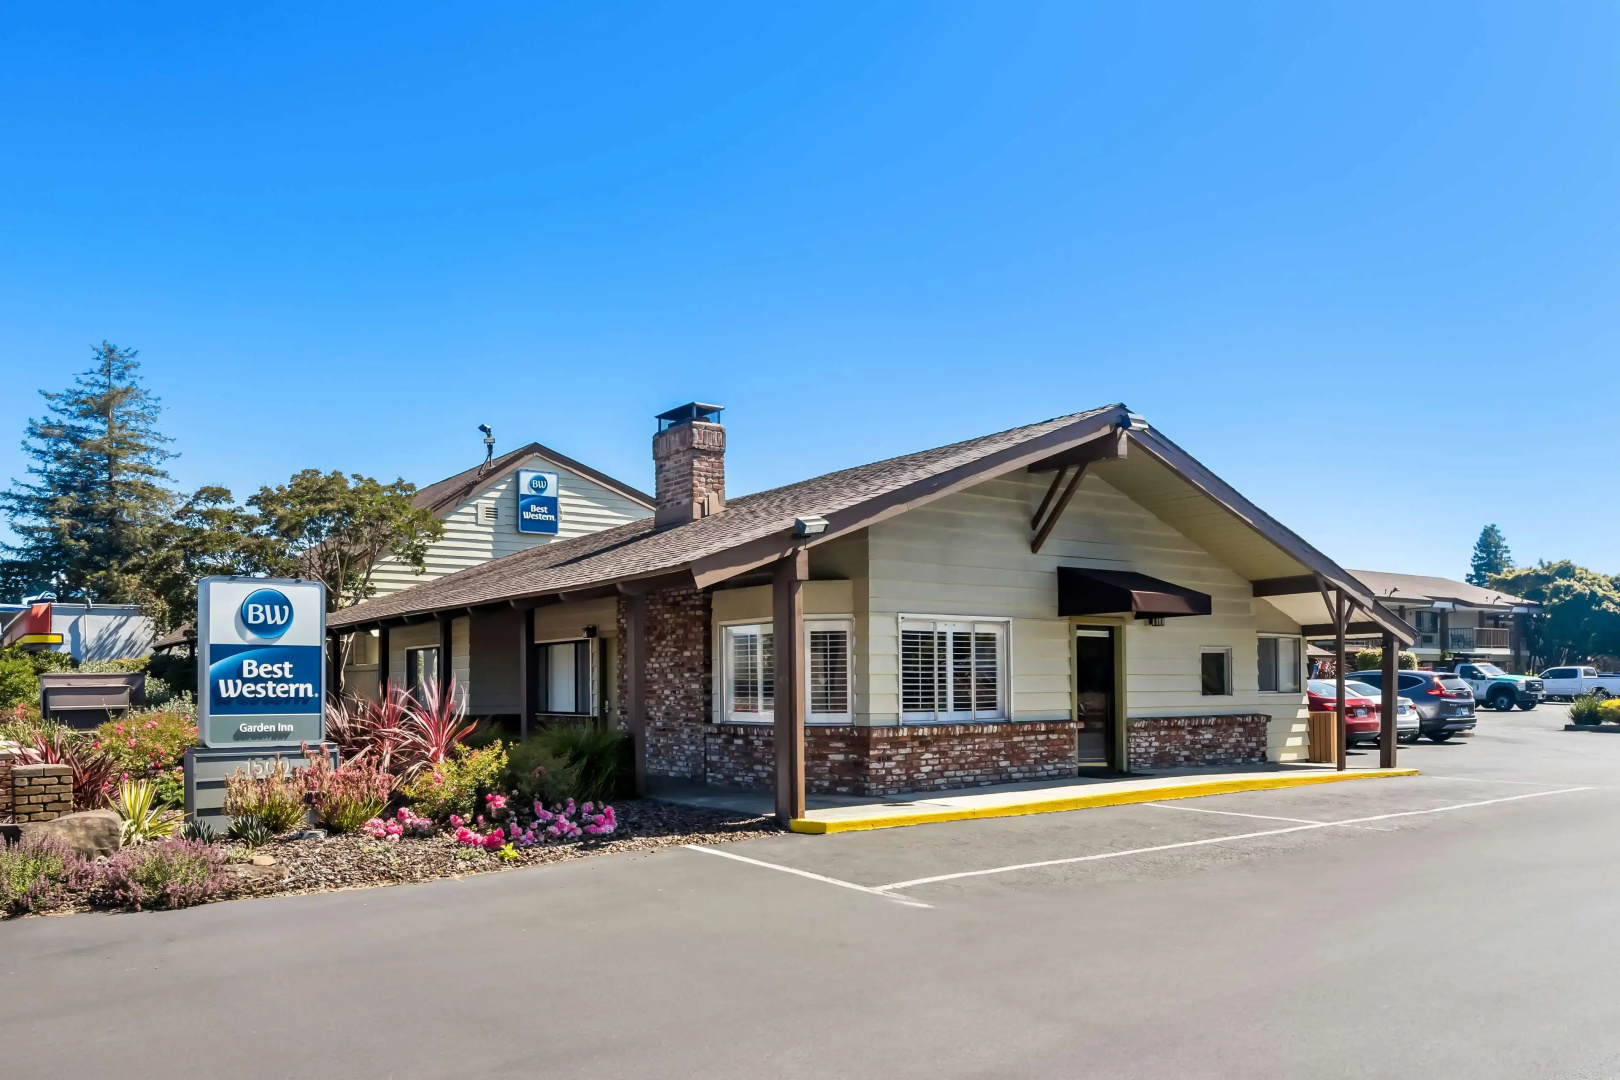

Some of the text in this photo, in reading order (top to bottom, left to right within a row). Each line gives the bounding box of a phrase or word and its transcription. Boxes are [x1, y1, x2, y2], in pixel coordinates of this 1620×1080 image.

[532, 480, 546, 488] BW
[530, 505, 548, 513] Best
[248, 604, 289, 625] BW
[242, 659, 293, 678] Best
[239, 722, 294, 732] Garden Inn
